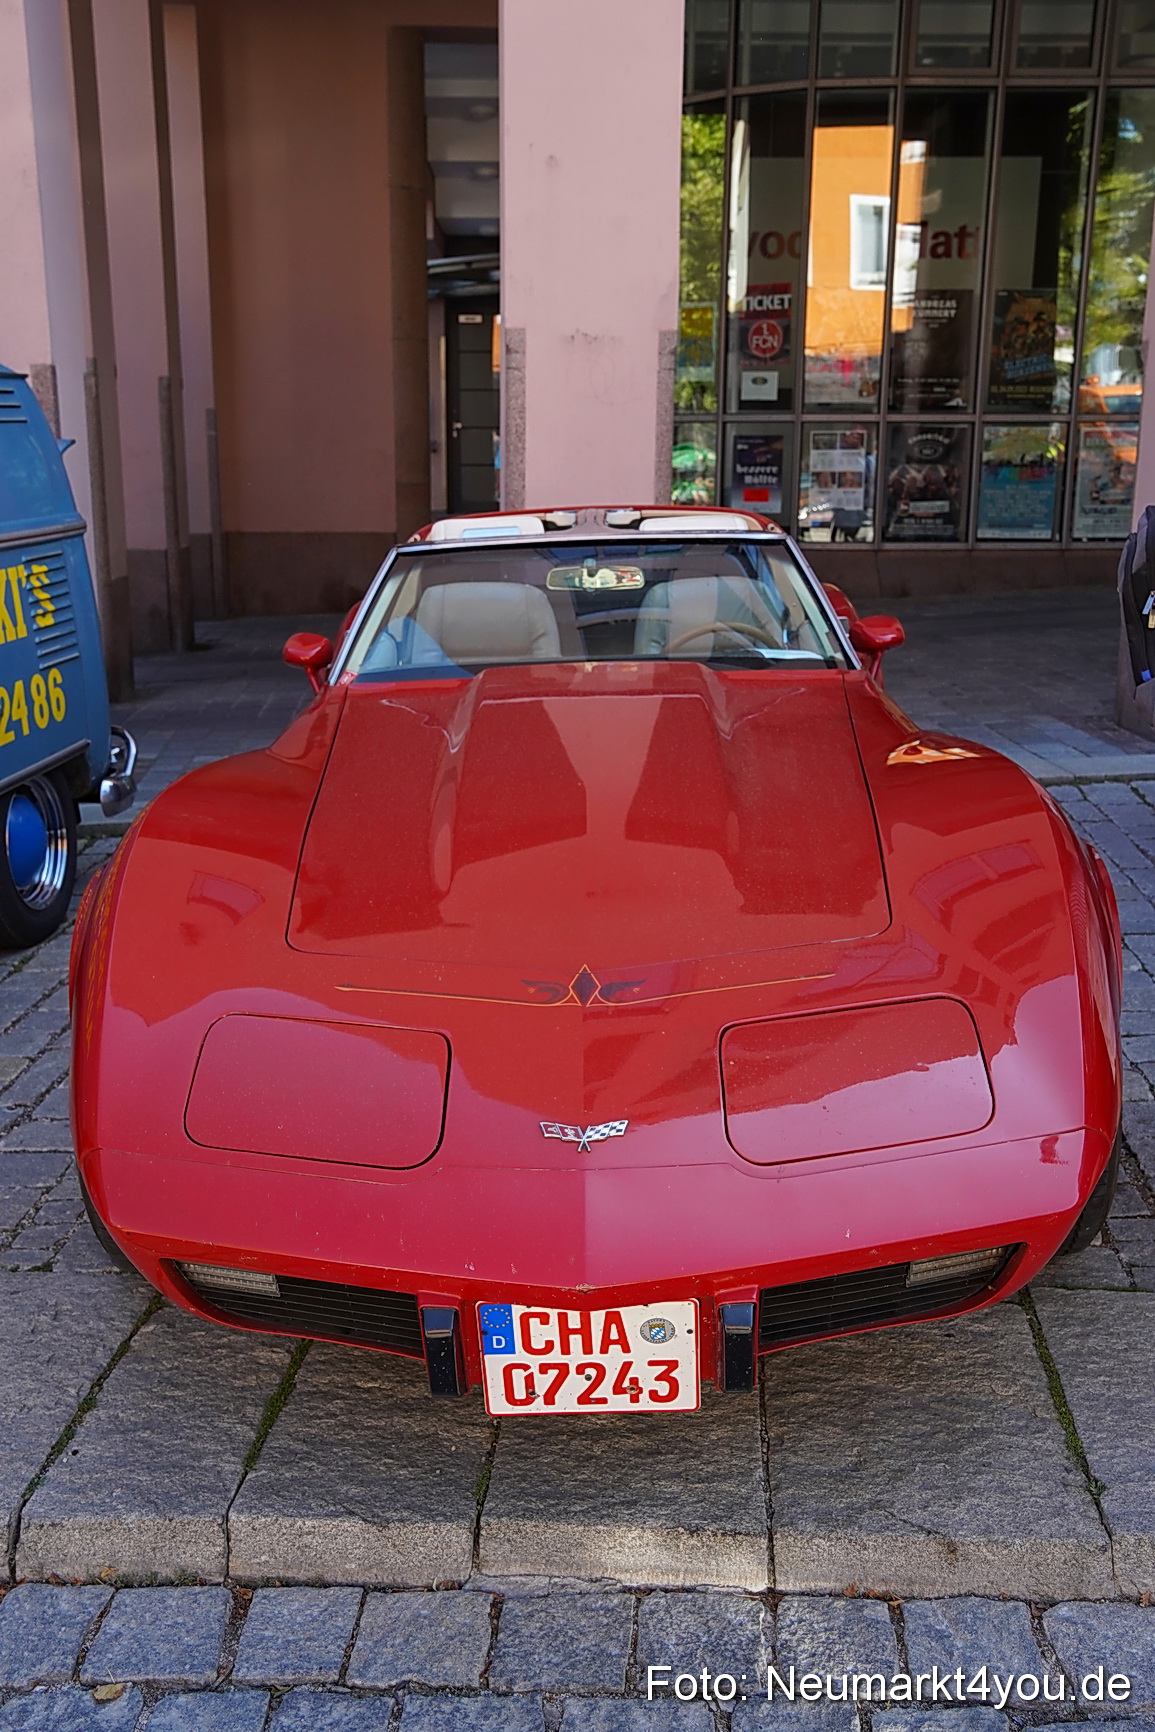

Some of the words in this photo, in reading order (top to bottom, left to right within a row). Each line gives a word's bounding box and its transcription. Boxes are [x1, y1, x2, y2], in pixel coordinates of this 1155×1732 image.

[743, 294, 793, 311] TICKET
[752, 335, 779, 349] FCN
[0, 668, 66, 746] 2486
[492, 1335, 506, 1349] D
[519, 1310, 631, 1355] CHA
[502, 1360, 680, 1406] 07243
